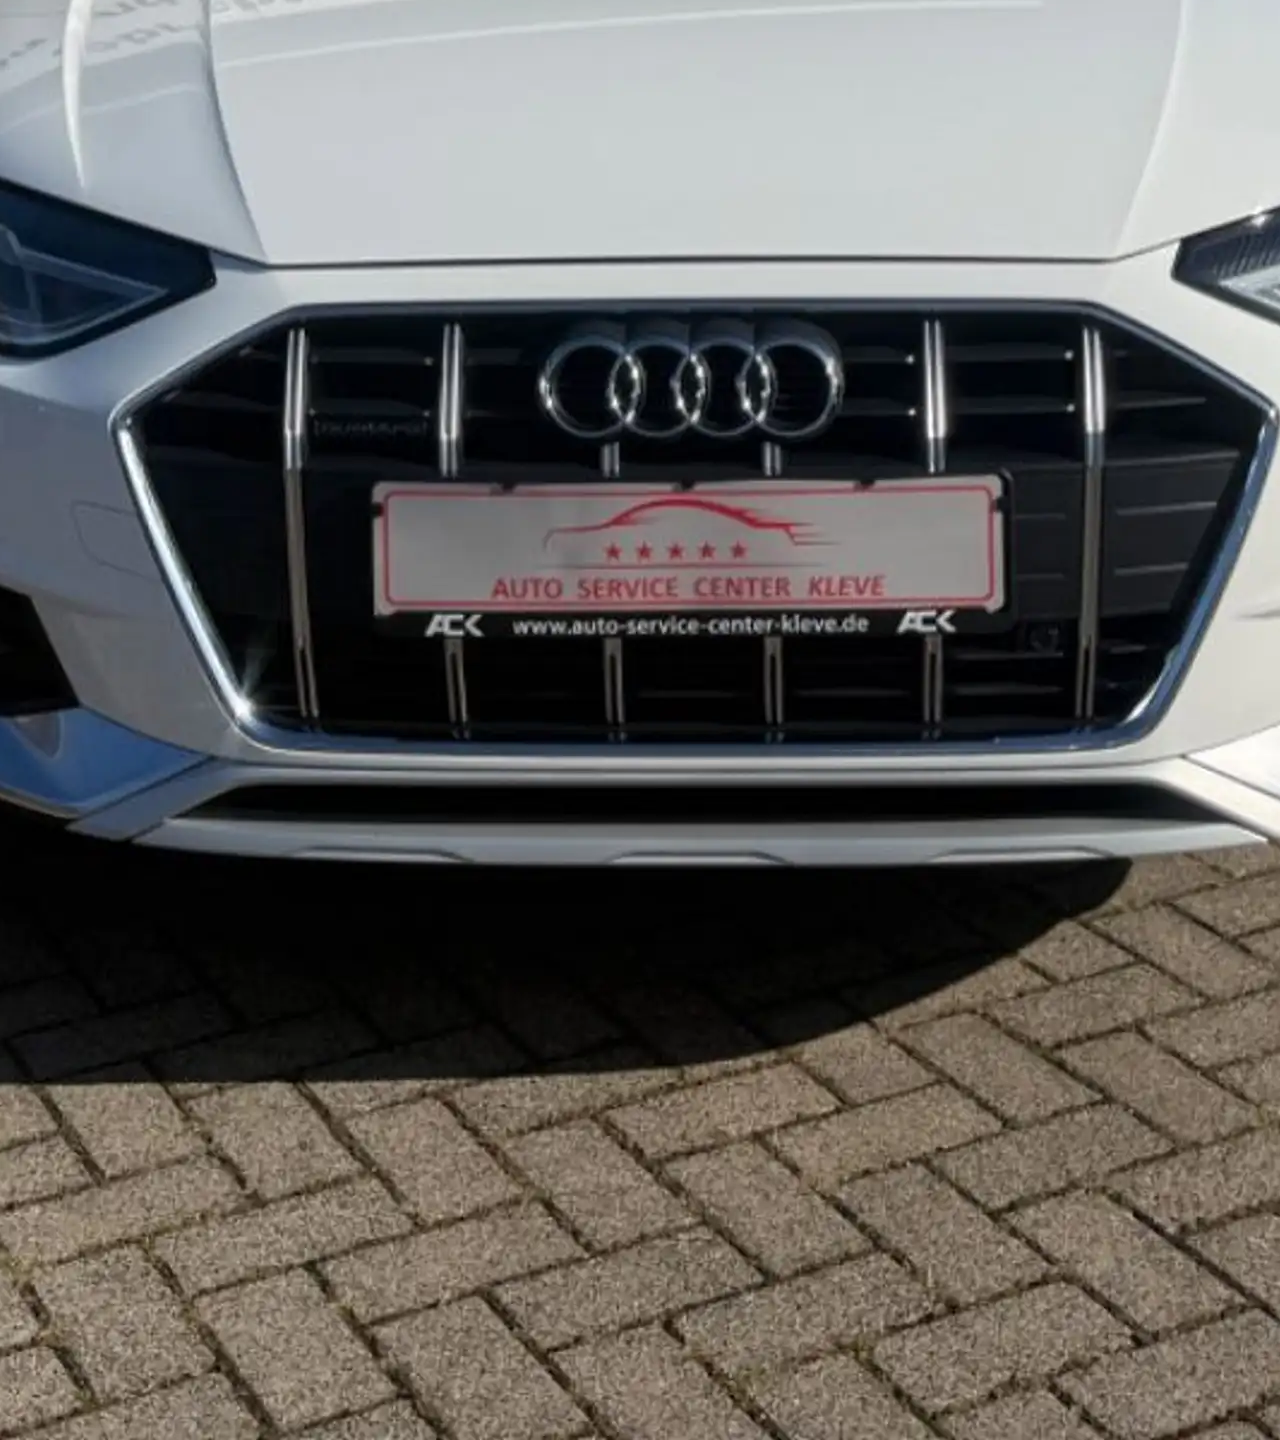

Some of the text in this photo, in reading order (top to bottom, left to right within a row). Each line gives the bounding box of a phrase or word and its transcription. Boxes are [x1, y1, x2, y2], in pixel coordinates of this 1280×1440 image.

[490, 574, 886, 601] AUTO SERVICE CENTER KLEVE
[512, 614, 870, 637] www.auto-service-center-kleve.de
